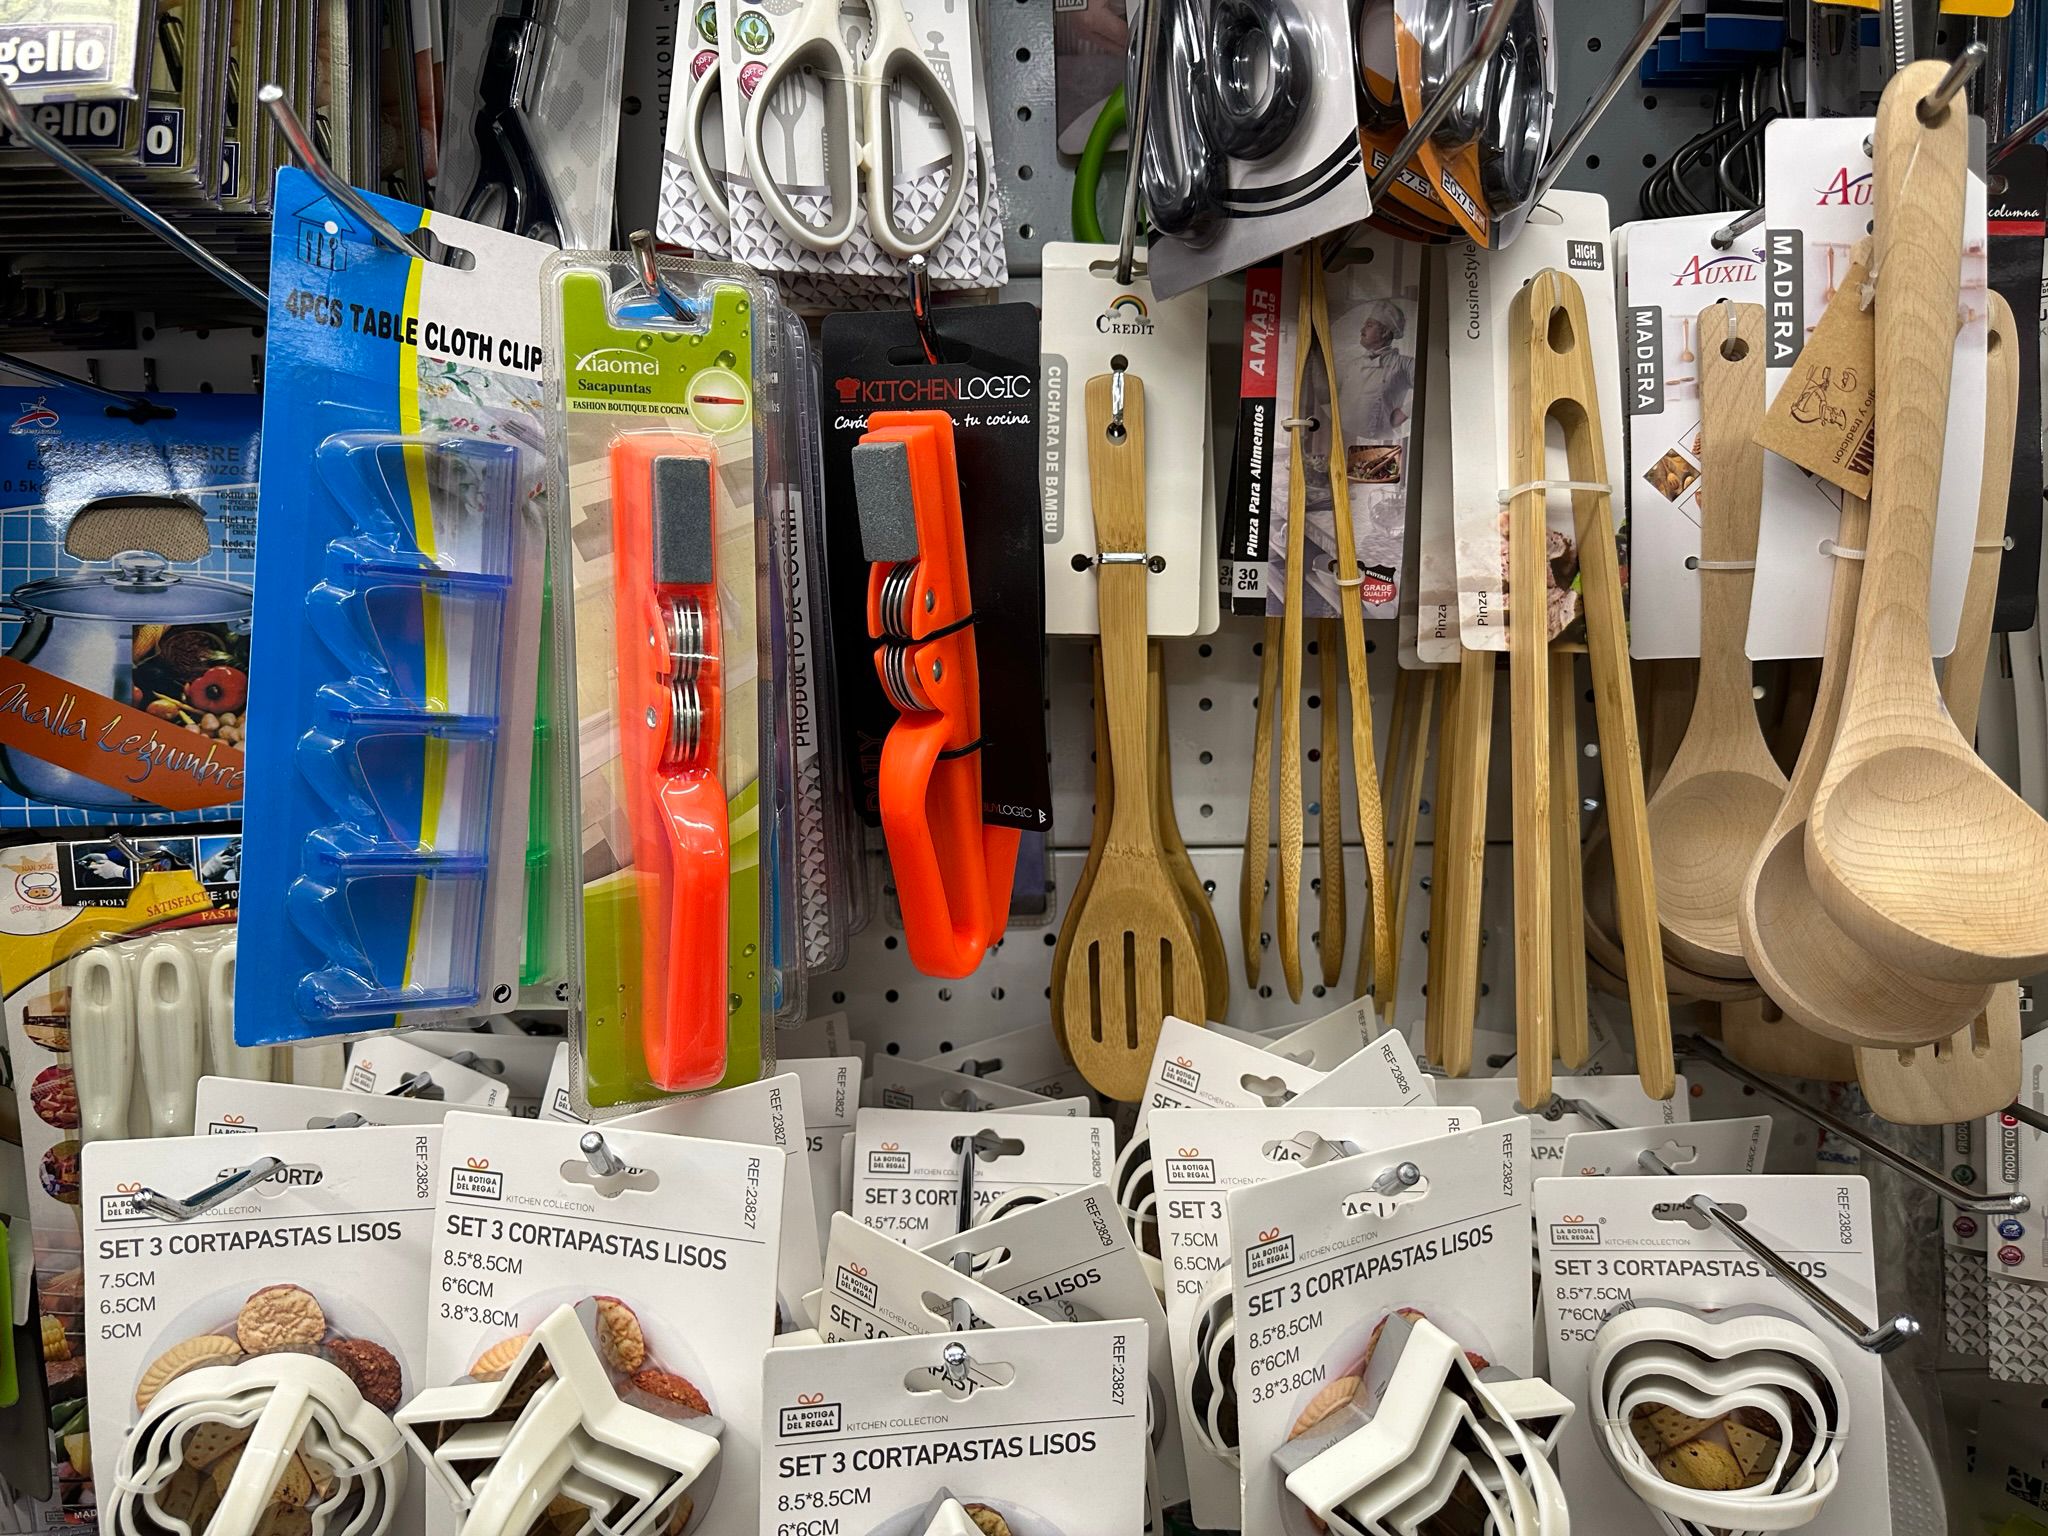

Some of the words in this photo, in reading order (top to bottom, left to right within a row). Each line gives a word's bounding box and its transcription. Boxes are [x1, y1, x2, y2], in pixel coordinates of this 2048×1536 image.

[1570, 258, 1602, 269] Quality
[1574, 244, 1597, 260] HIGH
[1672, 255, 1758, 287] AUXIL
[1463, 244, 1481, 340] CousineStyle
[1773, 235, 1794, 360] MADERA
[285, 287, 344, 329] 4PCS
[350, 303, 418, 346] TABLE
[424, 321, 493, 363] CLOTH
[1249, 288, 1269, 377] AMAR
[574, 350, 660, 376] Xiaomei
[1636, 311, 1655, 409] MADERA
[578, 378, 652, 395] Sacapuntas
[862, 374, 1032, 403] KITCHENLOGIC
[572, 401, 607, 411] FASHION
[607, 402, 648, 414] BOUTIQUE
[648, 404, 660, 414] DE
[660, 405, 690, 415] COCINA
[985, 410, 1031, 426] cocina
[1047, 365, 1061, 449] CUCHARA
[1250, 404, 1265, 486] Alimentos
[1046, 450, 1060, 473] DE
[1044, 476, 1060, 534] BAMBU
[1248, 487, 1261, 516] Para
[1246, 517, 1259, 557] Pinza
[1237, 580, 1259, 592] CM
[1238, 568, 1259, 580] 30
[1363, 584, 1393, 592] GRADE
[1435, 603, 1448, 639] Pinza
[1477, 589, 1489, 627] Pinza
[1380, 1043, 1410, 1095] REF:23826
[835, 1066, 847, 1118] REF:23827
[769, 1088, 787, 1146] REF:23827
[1090, 1127, 1103, 1178] REF:23829
[1502, 1132, 1514, 1197] REF:23827
[2004, 1129, 2017, 1181] PRODUCTO
[415, 1136, 429, 1199] REF:23826
[469, 1175, 497, 1185] BOTIGA
[456, 1183, 469, 1191] DEL
[471, 1184, 496, 1194] REGAL
[744, 1157, 760, 1230] REF:23827
[865, 1189, 898, 1205] SET
[901, 1189, 911, 1206] 3
[107, 1208, 122, 1216] DEL
[1082, 1196, 1114, 1247] REF:23829
[1168, 1201, 1206, 1219] SET
[1211, 1201, 1222, 1219] 3
[1837, 1186, 1853, 1245] REF:23829
[99, 1238, 145, 1260] SET
[150, 1236, 163, 1257] 3
[168, 1224, 332, 1255] CORTAPASTAS
[337, 1221, 402, 1244] LISOS
[446, 1214, 488, 1240] SET
[491, 1220, 504, 1241] 3
[508, 1222, 660, 1262] CORTAPASTAS
[664, 1242, 728, 1271] LISOS
[1171, 1232, 1219, 1247] 7.5CM
[1567, 1227, 1595, 1235] BOTIGA
[1174, 1256, 1221, 1271] 6.5CM
[1251, 1252, 1260, 1261] LA
[1262, 1243, 1289, 1258] BOTIGA
[1252, 1261, 1265, 1270] DEL
[1266, 1252, 1289, 1266] REGAL
[99, 1270, 156, 1289] 7.5CM
[1248, 1287, 1286, 1318] SET
[1290, 1282, 1302, 1303] 3
[1305, 1240, 1438, 1298] CORTAPASTAS
[1441, 1224, 1494, 1257] LISOS
[1554, 1259, 1592, 1276] SET
[1597, 1259, 1608, 1276] 3
[1613, 1259, 1760, 1278] CORTAPASTAS
[840, 1280, 852, 1291] DEL
[852, 1285, 873, 1302] REGAL
[841, 1272, 851, 1282] LA
[851, 1276, 873, 1295] BOTIGA
[1043, 1267, 1102, 1301] LISOS
[99, 1296, 157, 1315] 6.5CM
[100, 1322, 142, 1340] 5CM
[829, 1303, 862, 1333] SET
[865, 1322, 875, 1340] 3
[1560, 1329, 1599, 1342] 55C
[1111, 1334, 1126, 1405] REF:23827
[786, 1413, 798, 1421] LA
[800, 1409, 836, 1420] BOTIGA
[786, 1421, 802, 1430] DEL
[805, 1417, 834, 1429] REGAL
[846, 1419, 888, 1432] KITCHEN
[889, 1414, 949, 1428] COLLECTION
[778, 1453, 827, 1478] SET
[832, 1451, 846, 1473] 3
[852, 1435, 1023, 1472] CORTAPASTAS
[1029, 1430, 1097, 1457] LISOS
